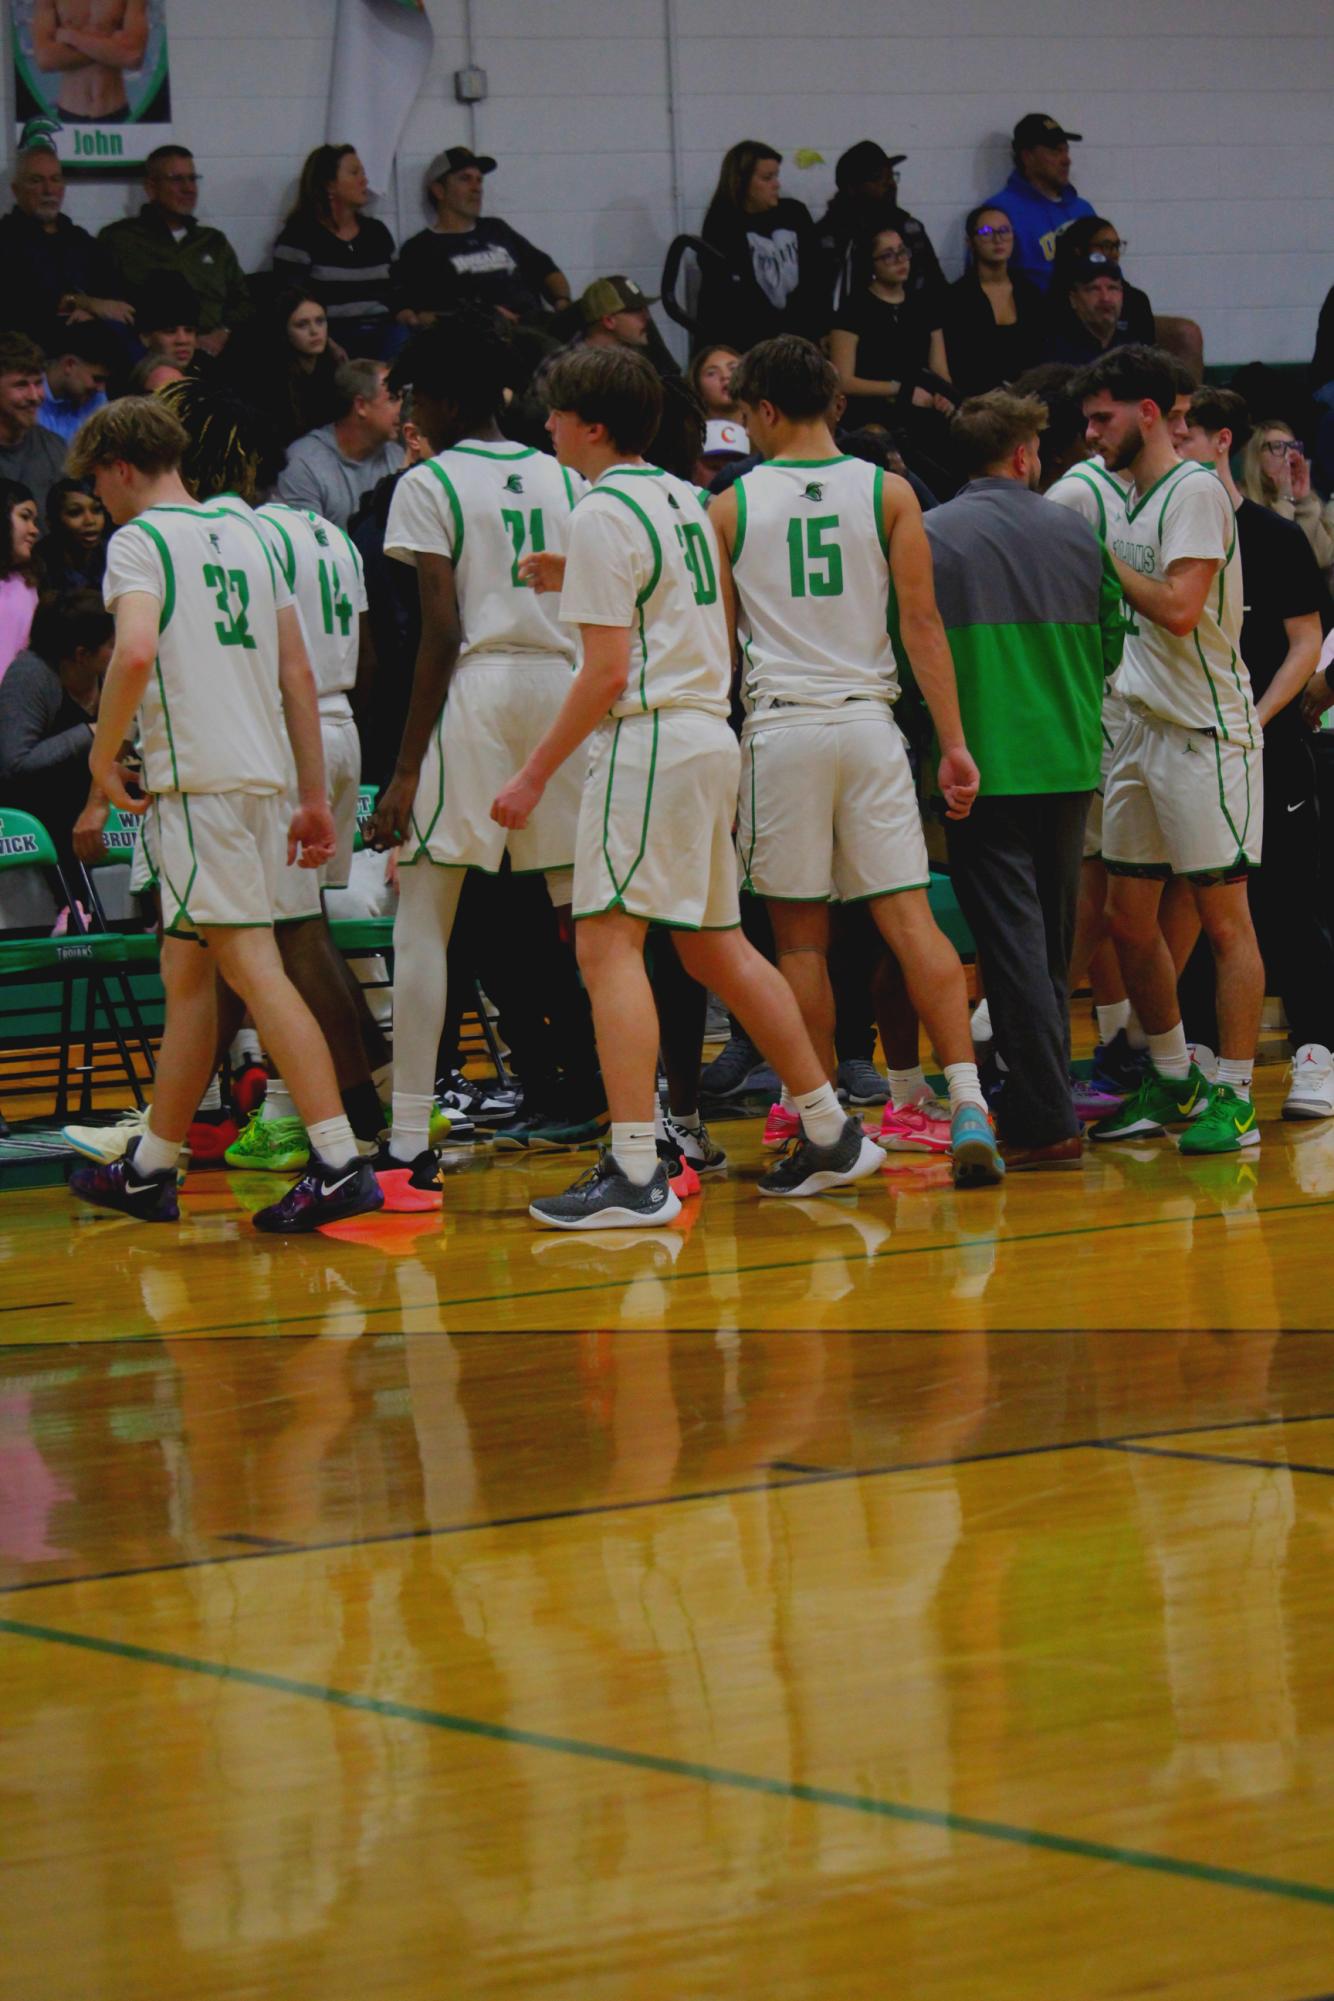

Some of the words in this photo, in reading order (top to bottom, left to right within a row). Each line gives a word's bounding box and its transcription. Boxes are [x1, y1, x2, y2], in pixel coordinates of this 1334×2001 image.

[73, 129, 124, 156] John
[786, 514, 844, 598] 15
[202, 563, 257, 650] 32
[318, 558, 353, 637] 14
